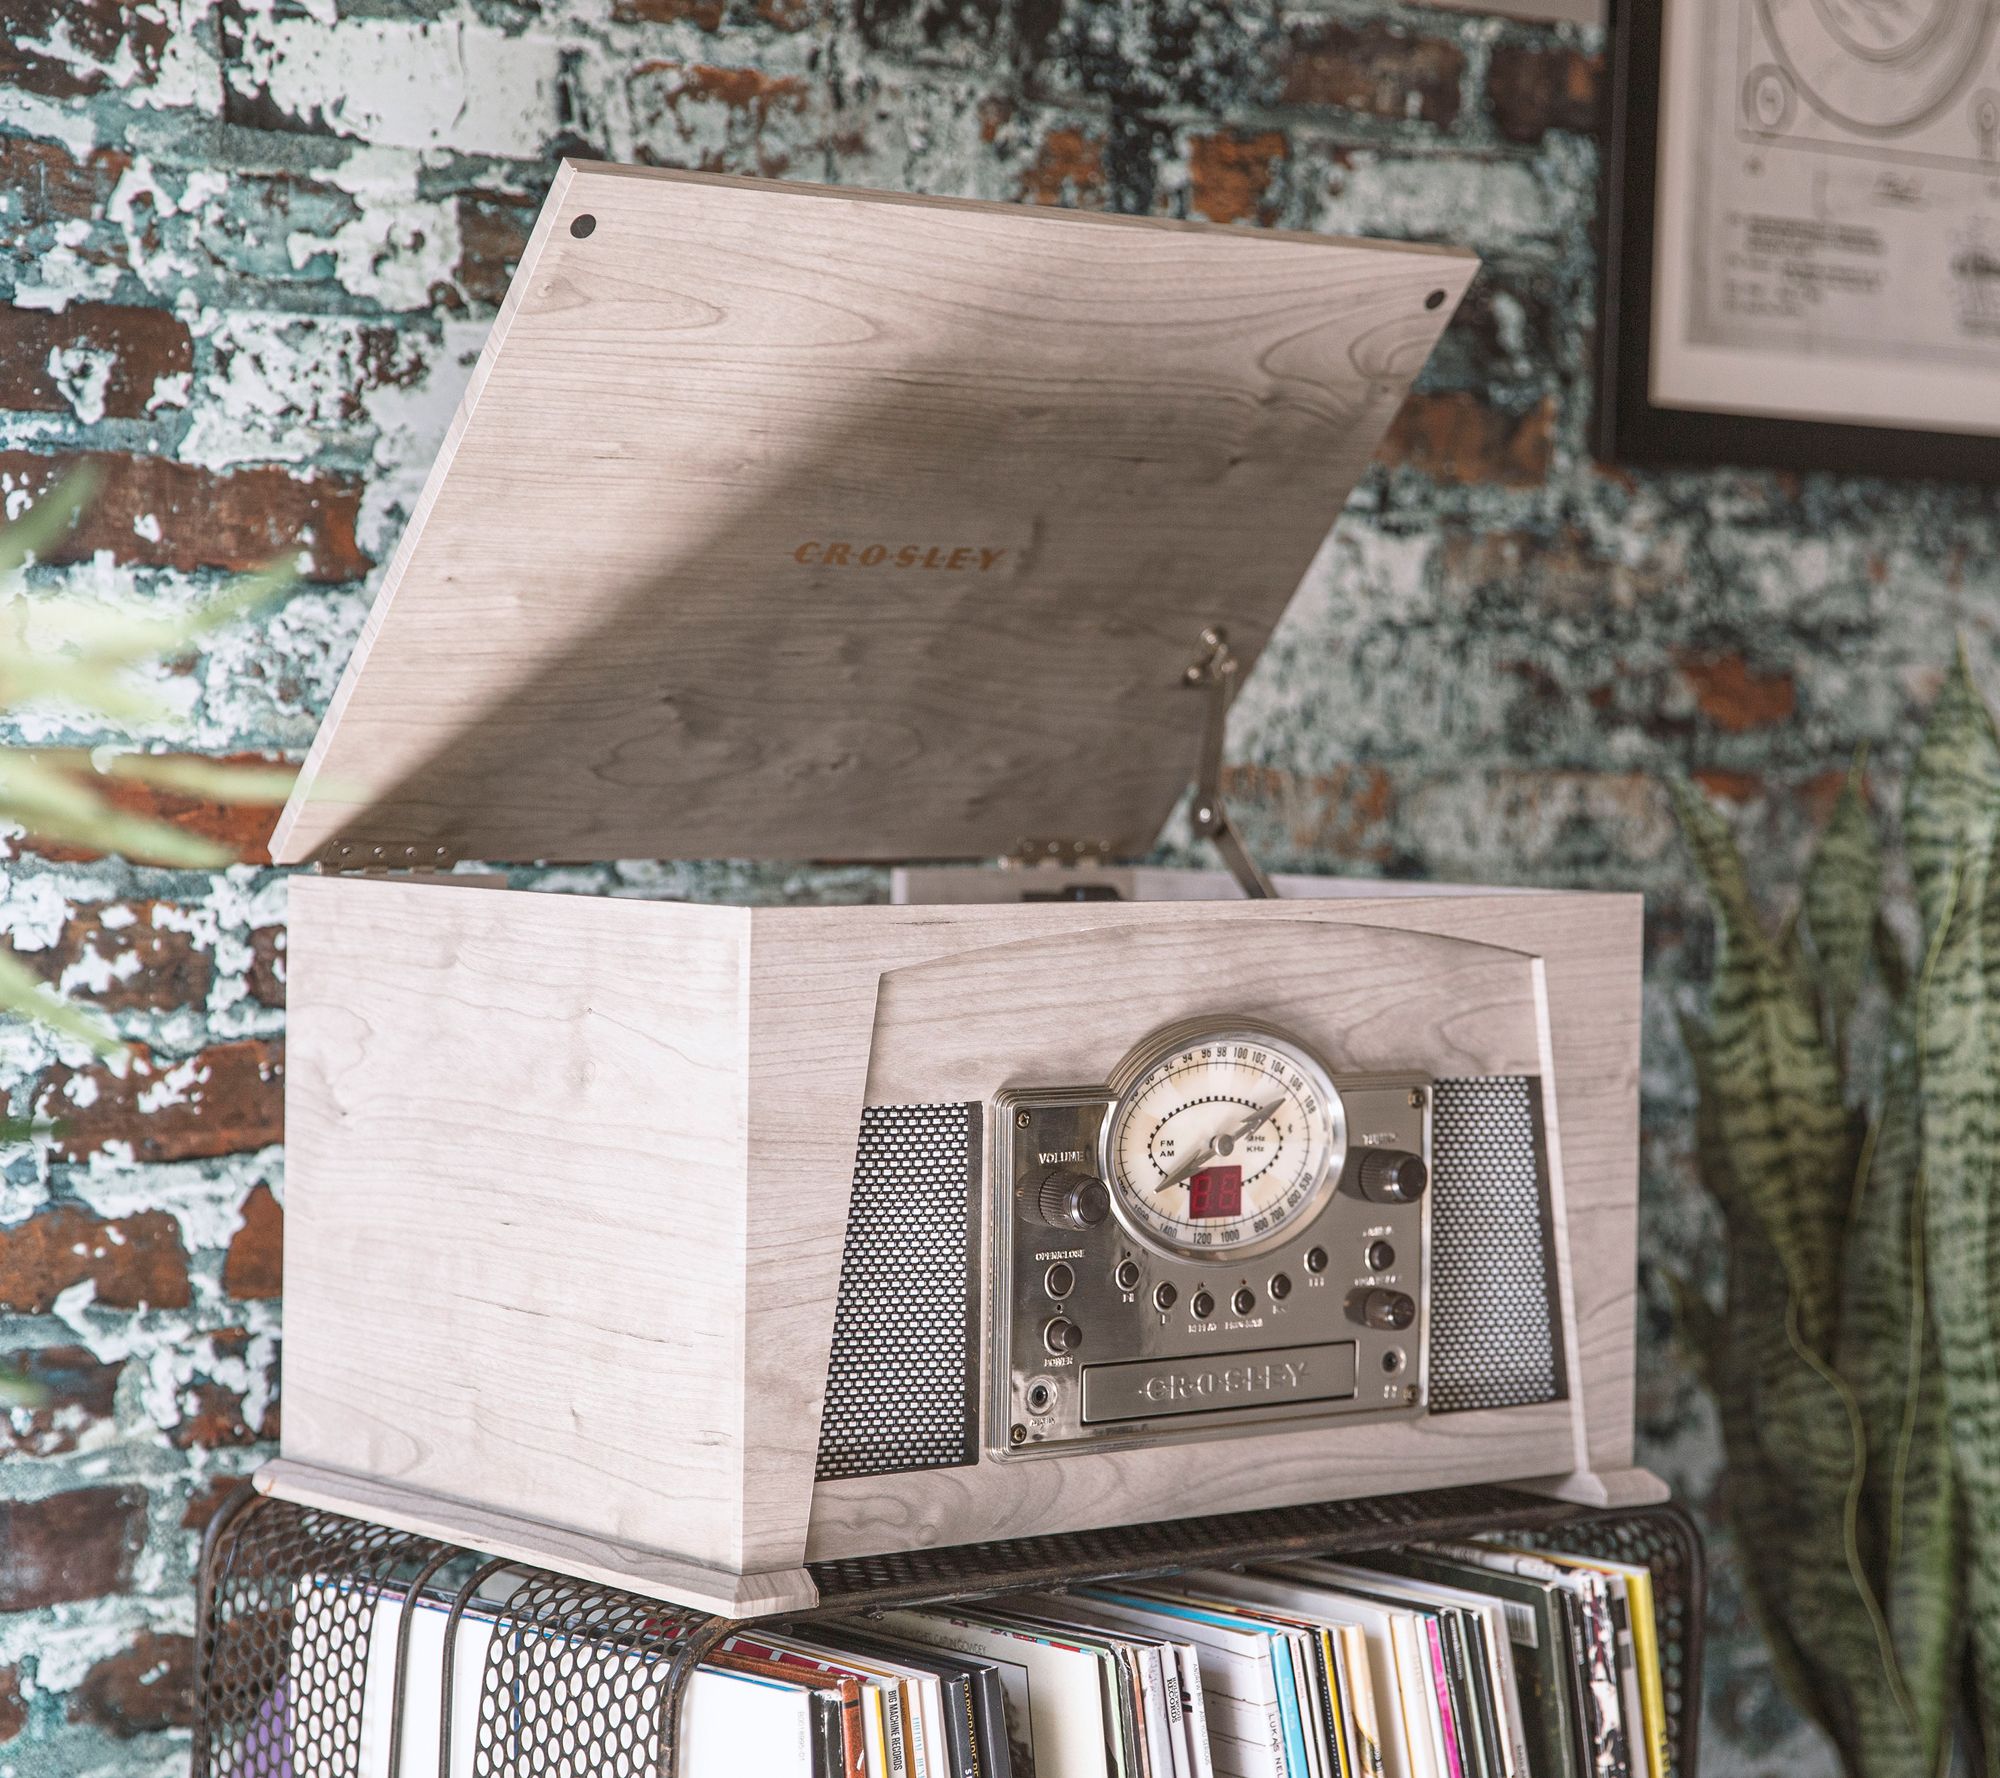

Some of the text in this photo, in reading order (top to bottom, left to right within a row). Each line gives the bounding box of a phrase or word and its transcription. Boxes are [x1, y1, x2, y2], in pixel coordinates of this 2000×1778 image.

[793, 541, 1007, 572] CROSLEY
[1201, 1048, 1212, 1059] 96
[1216, 1047, 1227, 1057] 98
[1234, 1047, 1248, 1060] 100
[1252, 1051, 1267, 1065] 102
[1270, 1059, 1285, 1075] 104
[1289, 1074, 1304, 1092] 106
[1304, 1095, 1317, 1114] 108
[1038, 1151, 1085, 1165] VOLUME
[1160, 1223, 1178, 1239] 1400
[1193, 1232, 1212, 1245] 1200
[1221, 1229, 1240, 1243] 1000
[1269, 1206, 1285, 1223] 700
[1299, 1172, 1313, 1192] 530
[1145, 1361, 1310, 1401] CROSLEY
[1166, 1678, 1177, 1723] RECORDS
[1172, 1677, 1182, 1722] HOLLYWOOD
[888, 1690, 903, 1771] BIG MACHINE RECORDS
[1268, 1713, 1281, 1751] LUKAS
